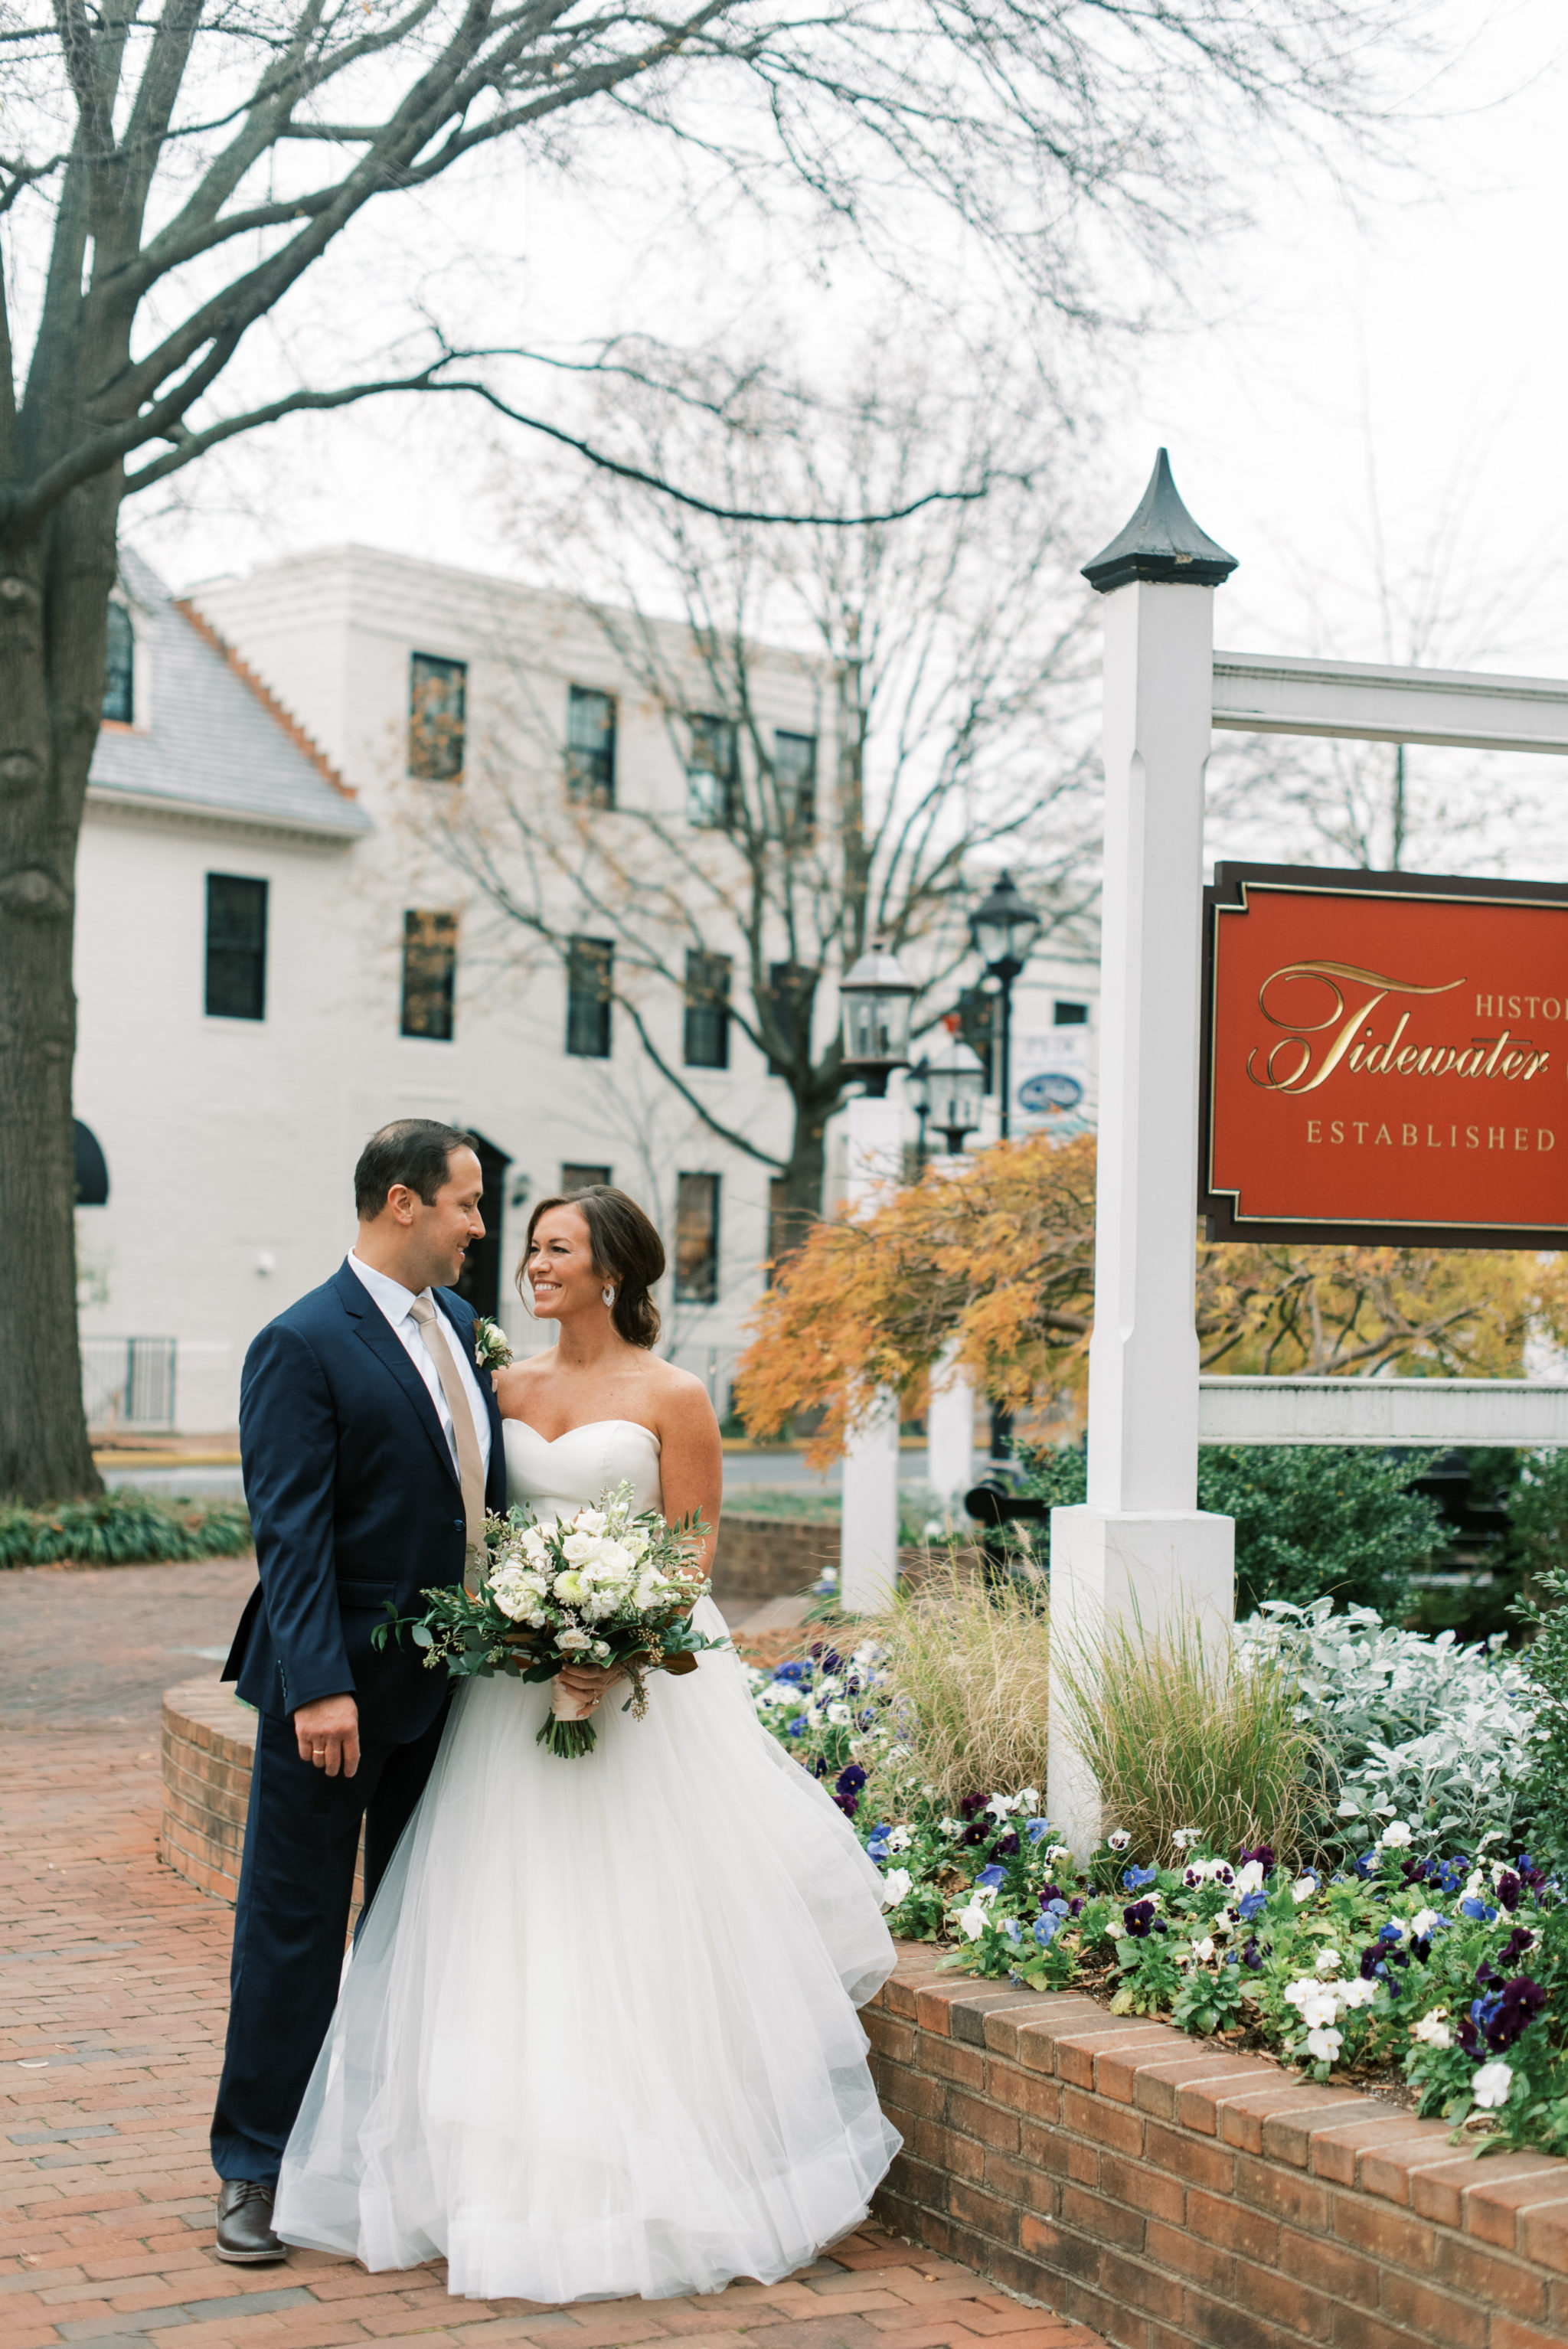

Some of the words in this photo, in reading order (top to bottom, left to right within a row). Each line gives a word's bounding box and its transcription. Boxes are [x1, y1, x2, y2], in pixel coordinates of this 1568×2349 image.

[1475, 994, 1568, 1021] HISTO
[1246, 959, 1550, 1095] Tidewater
[1306, 1119, 1555, 1152] ESTABLISHED
